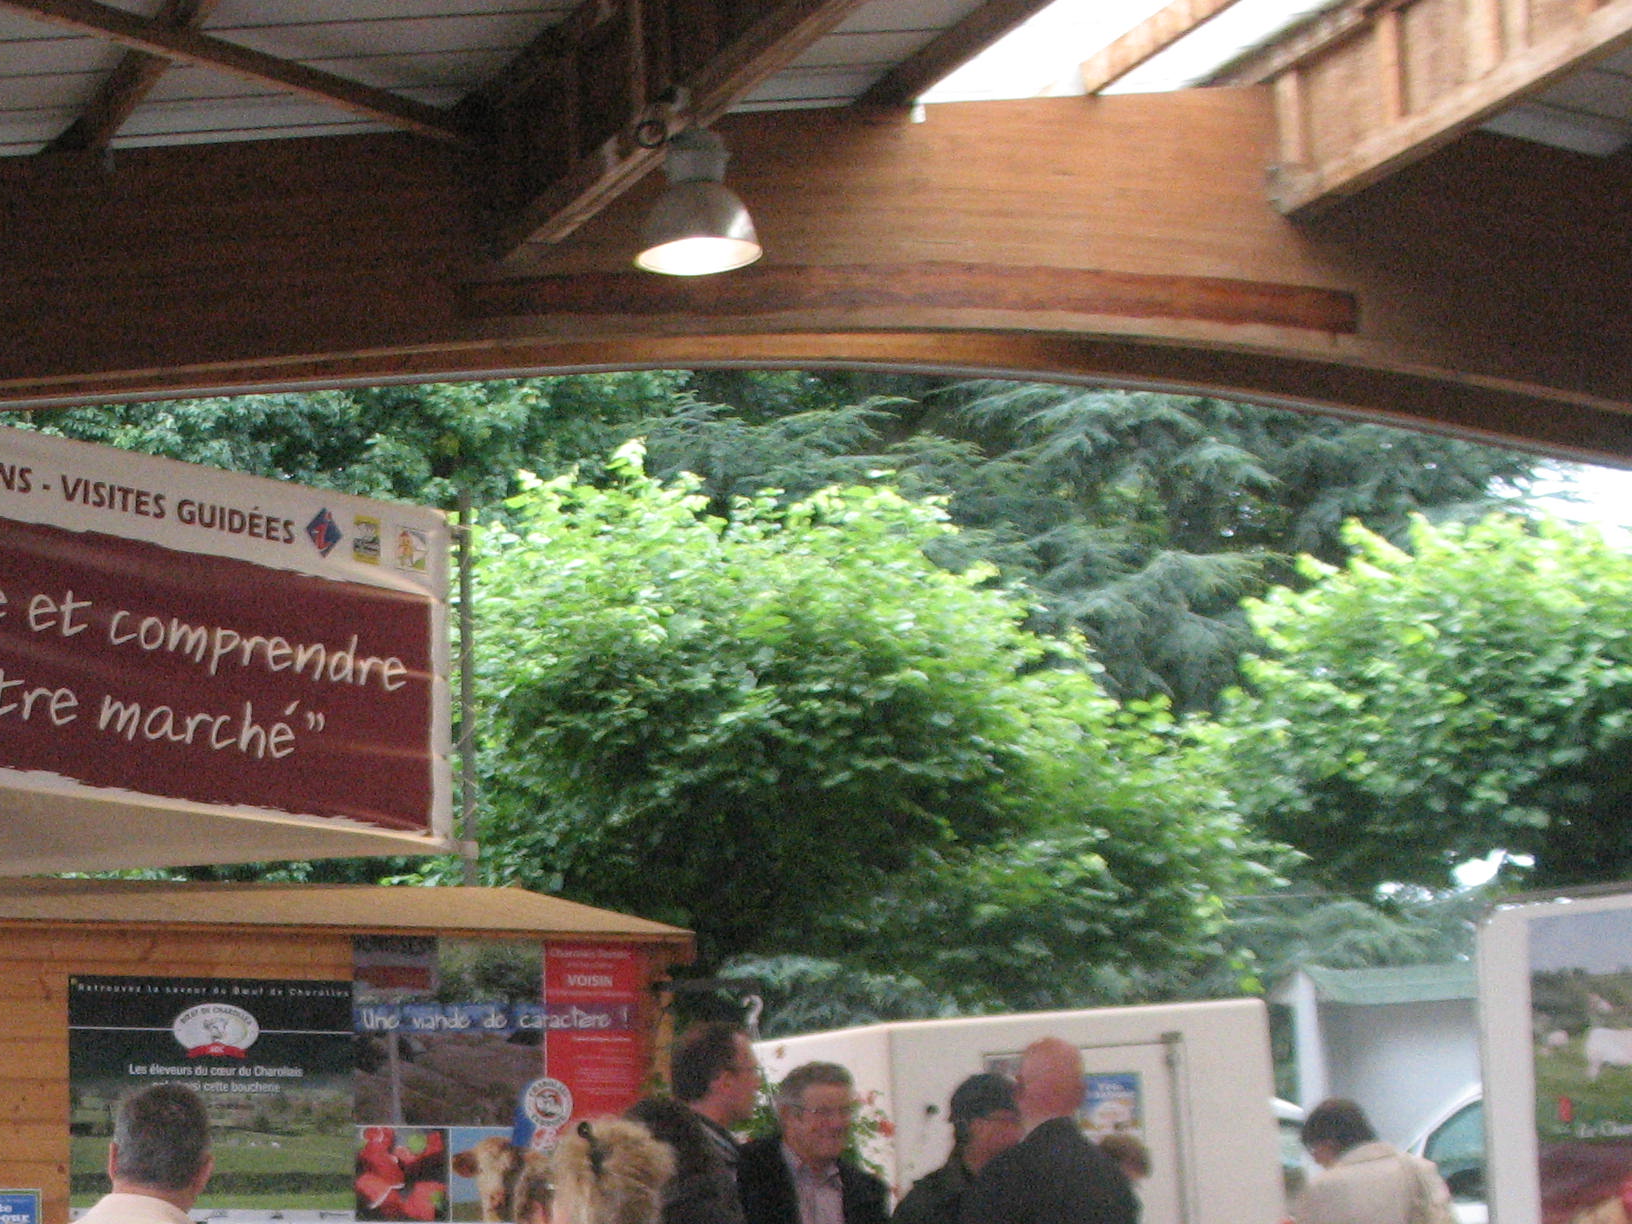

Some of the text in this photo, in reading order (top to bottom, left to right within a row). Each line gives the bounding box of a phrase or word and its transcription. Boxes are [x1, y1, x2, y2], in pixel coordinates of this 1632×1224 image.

[60, 474, 167, 519] VISITES
[176, 499, 297, 545] GUIDÉES
[28, 589, 93, 637] et
[109, 607, 409, 692] comprendre
[568, 974, 614, 987] VOISIN
[362, 1008, 400, 1030] Une
[483, 1009, 508, 1029] de
[129, 1064, 148, 1075] Les
[150, 1064, 193, 1077] éleveurs
[195, 1065, 208, 1077] du
[239, 1066, 252, 1077] du
